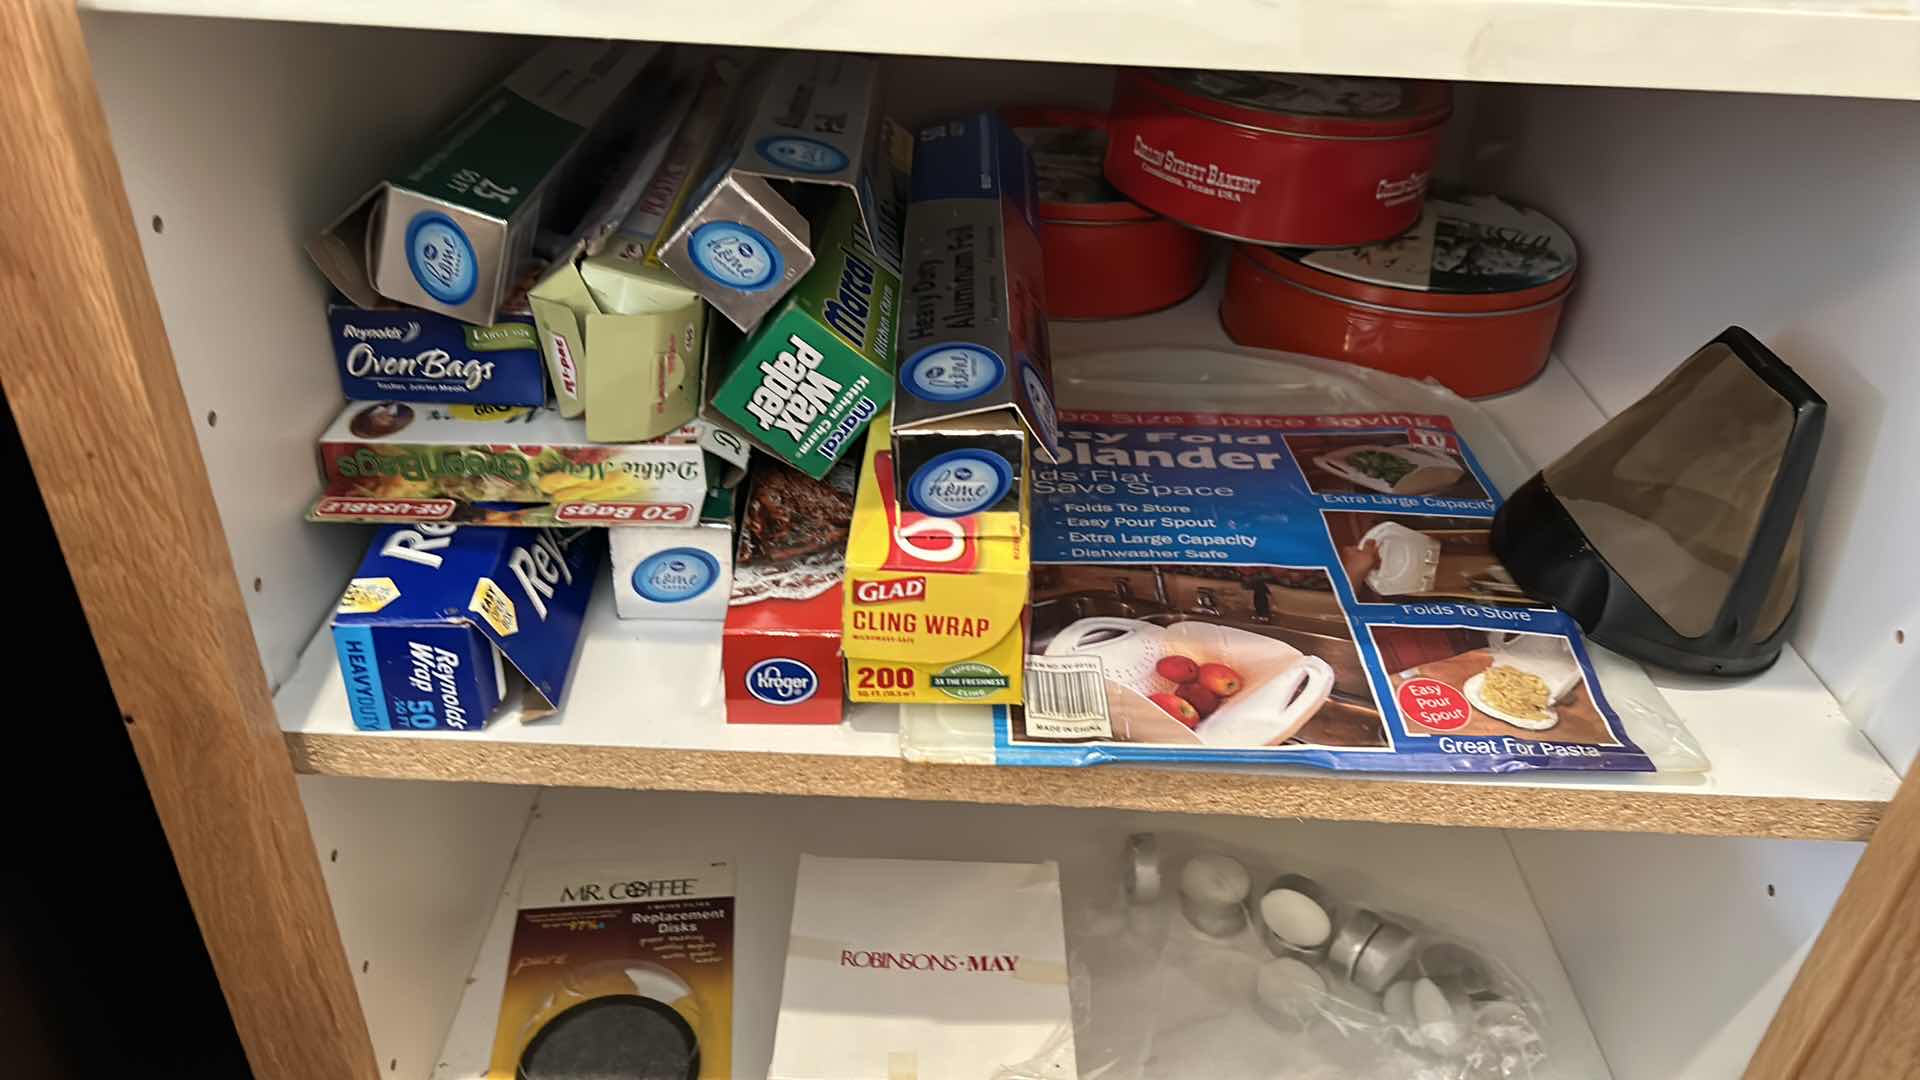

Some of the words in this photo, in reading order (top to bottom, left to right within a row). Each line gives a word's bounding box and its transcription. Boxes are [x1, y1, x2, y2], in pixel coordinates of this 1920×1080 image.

[1164, 150, 1207, 182] STREET
[1206, 163, 1261, 194] BAKERY
[346, 342, 416, 378] Oven
[416, 347, 496, 391] Bags
[746, 334, 824, 431] Paper
[774, 369, 843, 443] Wax
[1111, 412, 1185, 426] Size
[1195, 414, 1305, 427] Space
[1144, 431, 1272, 445] Fold
[1033, 441, 1281, 471] olander
[622, 459, 700, 481] Debbie
[1091, 469, 1153, 484] Flat
[928, 470, 989, 498] home
[1033, 480, 1117, 496] Save
[1126, 481, 1235, 498] Space
[320, 501, 449, 516] RE-USABLE
[562, 502, 638, 521] Bags
[1064, 503, 1112, 514] Folds
[1118, 503, 1136, 514] To
[1142, 504, 1192, 514] Store
[1322, 493, 1368, 506] Extra
[1371, 494, 1419, 508] Large
[1423, 497, 1497, 511] Capacity
[641, 504, 677, 520] 20
[1066, 516, 1110, 530] Easy
[1114, 516, 1157, 528] Pour
[1160, 518, 1217, 530] Spout
[1068, 532, 1117, 545] Extra
[1120, 533, 1173, 547] Large
[1178, 533, 1258, 548] Capacity
[1071, 548, 1181, 560] Dishwasher
[1184, 549, 1229, 560] Safe
[857, 580, 924, 601] GLAD
[1401, 603, 1457, 617] Folds
[1458, 604, 1480, 618] To
[1483, 605, 1533, 622] Store
[852, 610, 917, 633] CLING
[924, 615, 990, 638] WRAP
[407, 640, 434, 693] Wrap
[756, 666, 809, 697] Kroger
[857, 667, 915, 689] 200
[431, 646, 469, 730] Reynolds
[1407, 685, 1442, 697] Easy
[1415, 697, 1452, 710] Pour
[406, 700, 437, 729] 50
[1420, 708, 1466, 724] Spout
[1438, 737, 1499, 755] Great
[1503, 738, 1536, 755] For
[1541, 742, 1601, 758] Pasta
[560, 884, 604, 903] MR.
[609, 877, 700, 901] COFFEE
[631, 909, 726, 925] Replacement
[658, 921, 699, 934] Disks
